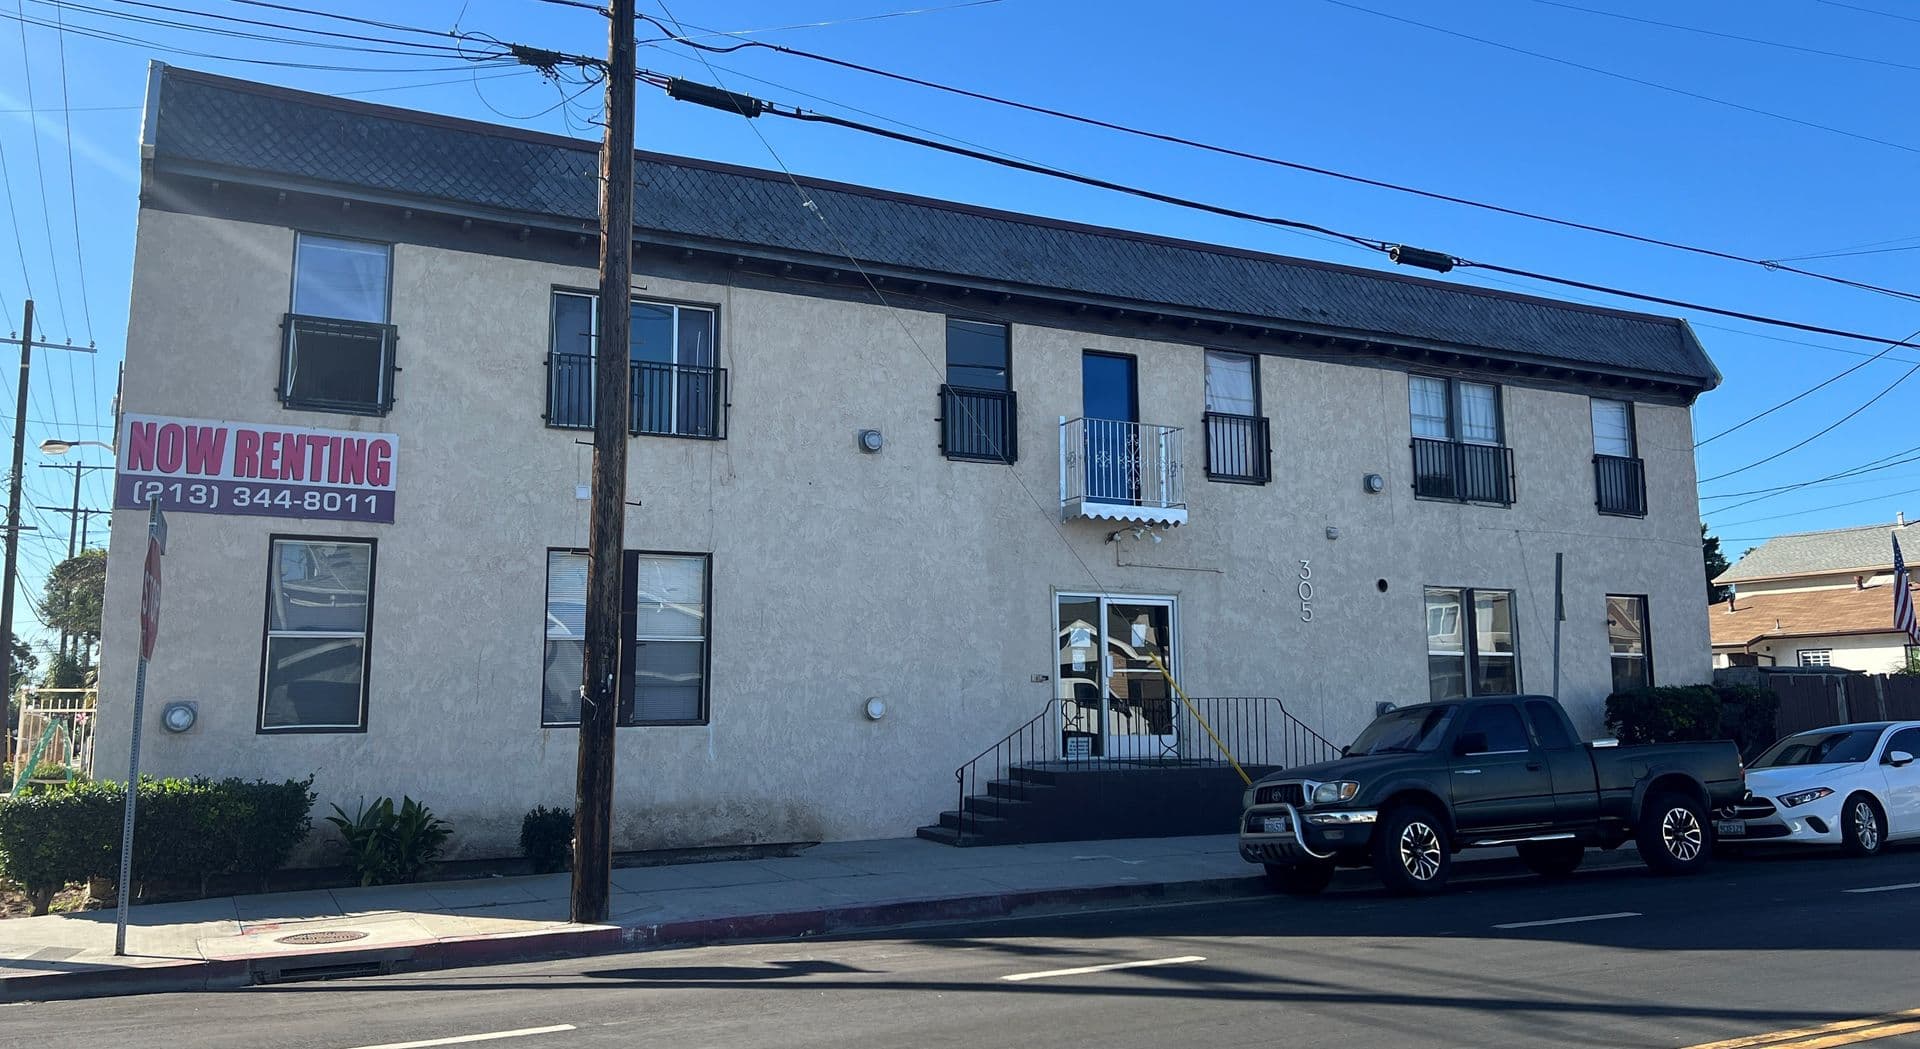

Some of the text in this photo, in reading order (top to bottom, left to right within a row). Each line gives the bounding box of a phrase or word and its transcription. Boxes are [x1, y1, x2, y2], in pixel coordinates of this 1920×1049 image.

[127, 421, 392, 487] NOW RENTING
[133, 480, 377, 514] (213) 344-8011
[142, 570, 161, 624] STOP
[1298, 559, 1313, 622] 305
